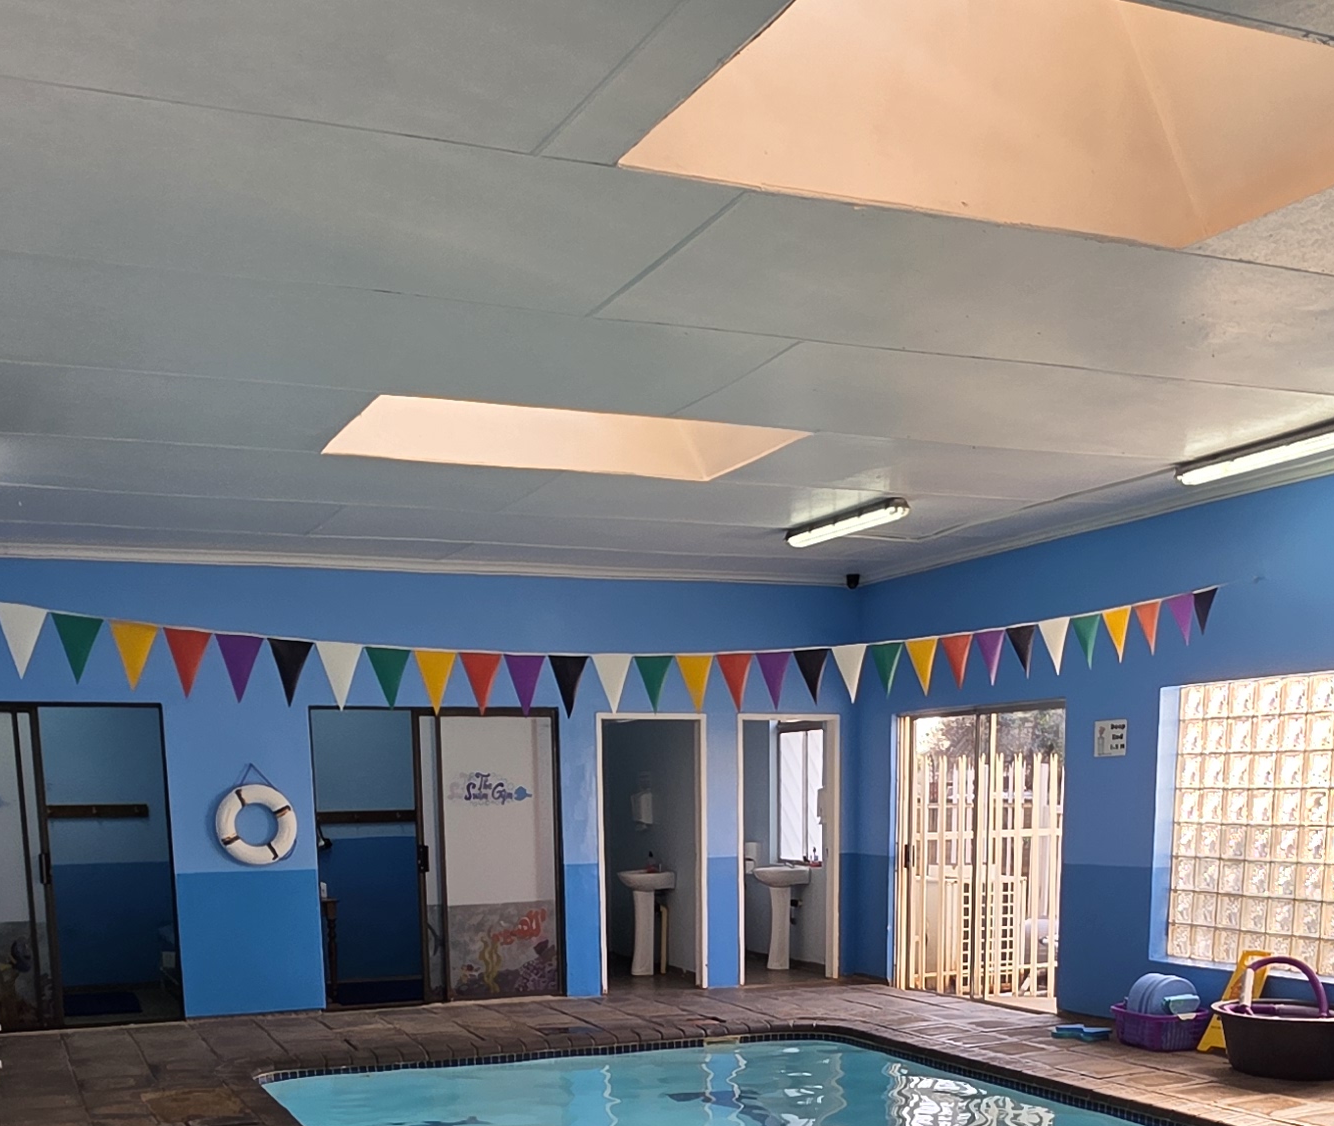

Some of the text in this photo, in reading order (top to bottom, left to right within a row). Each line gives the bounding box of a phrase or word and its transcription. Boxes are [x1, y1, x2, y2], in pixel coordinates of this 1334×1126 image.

[474, 772, 493, 791] The
[464, 782, 513, 806] Swim Gym
